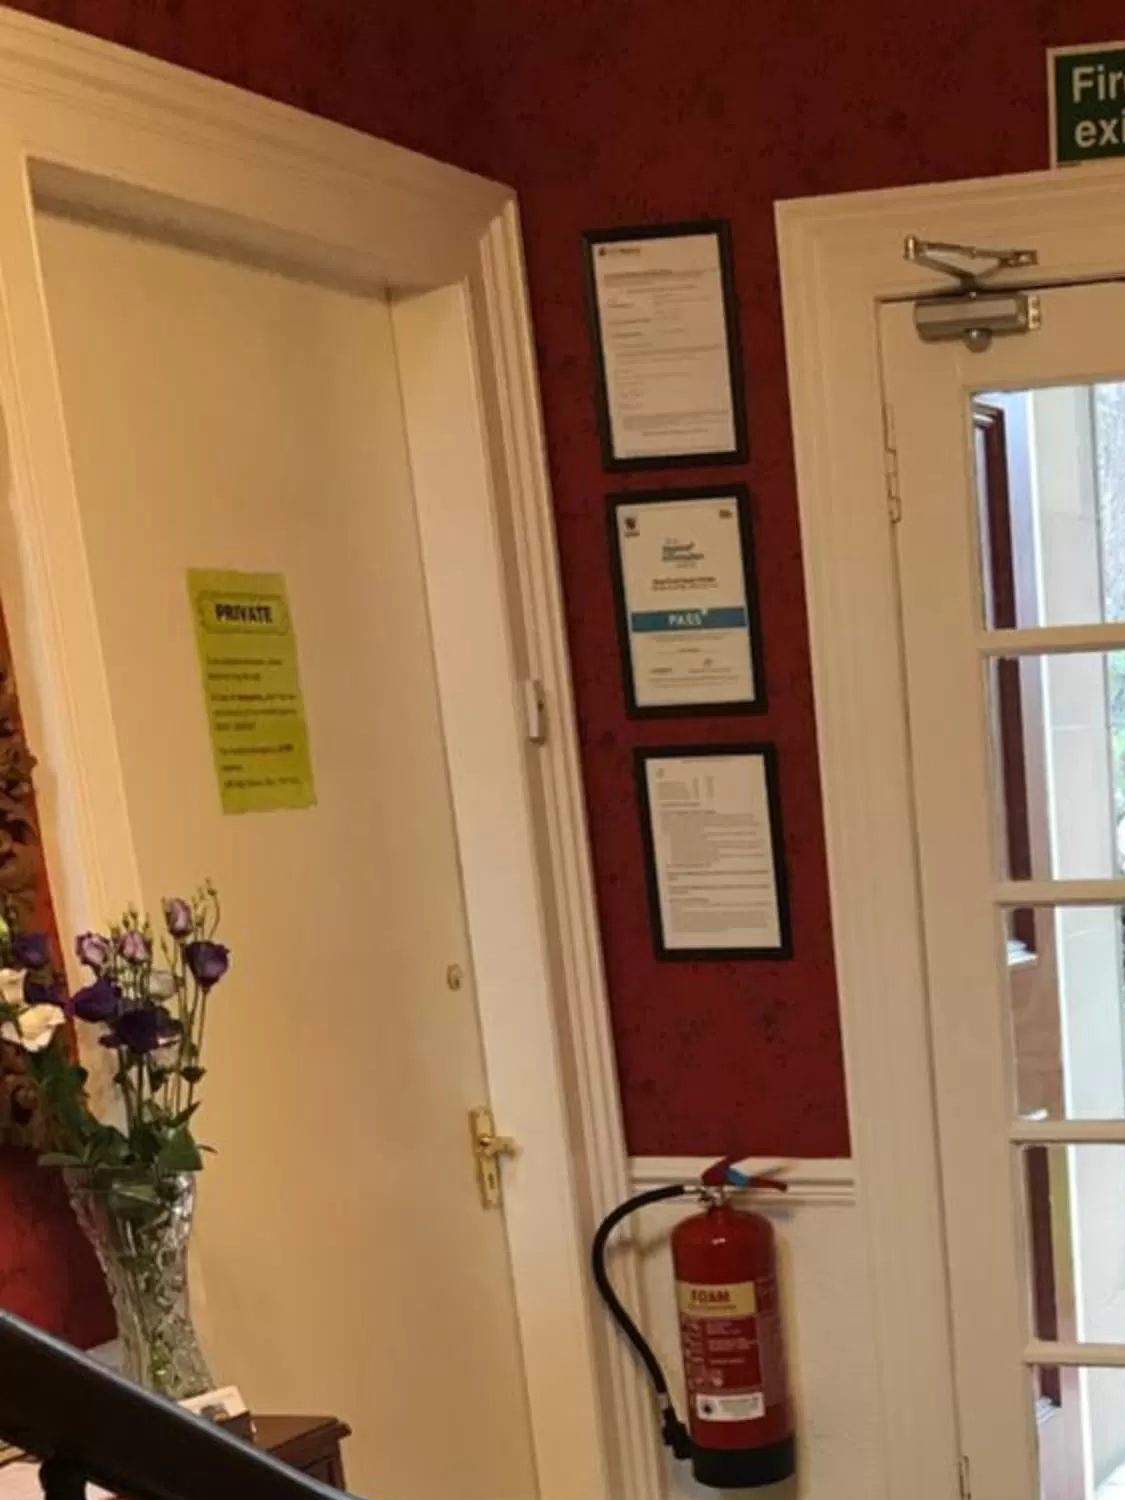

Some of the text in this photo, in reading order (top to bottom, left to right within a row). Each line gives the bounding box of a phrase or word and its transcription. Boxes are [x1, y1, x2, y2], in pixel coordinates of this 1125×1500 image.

[215, 603, 273, 623] PRIVATE
[668, 612, 702, 625] PASS
[690, 1289, 731, 1302] FOAM
